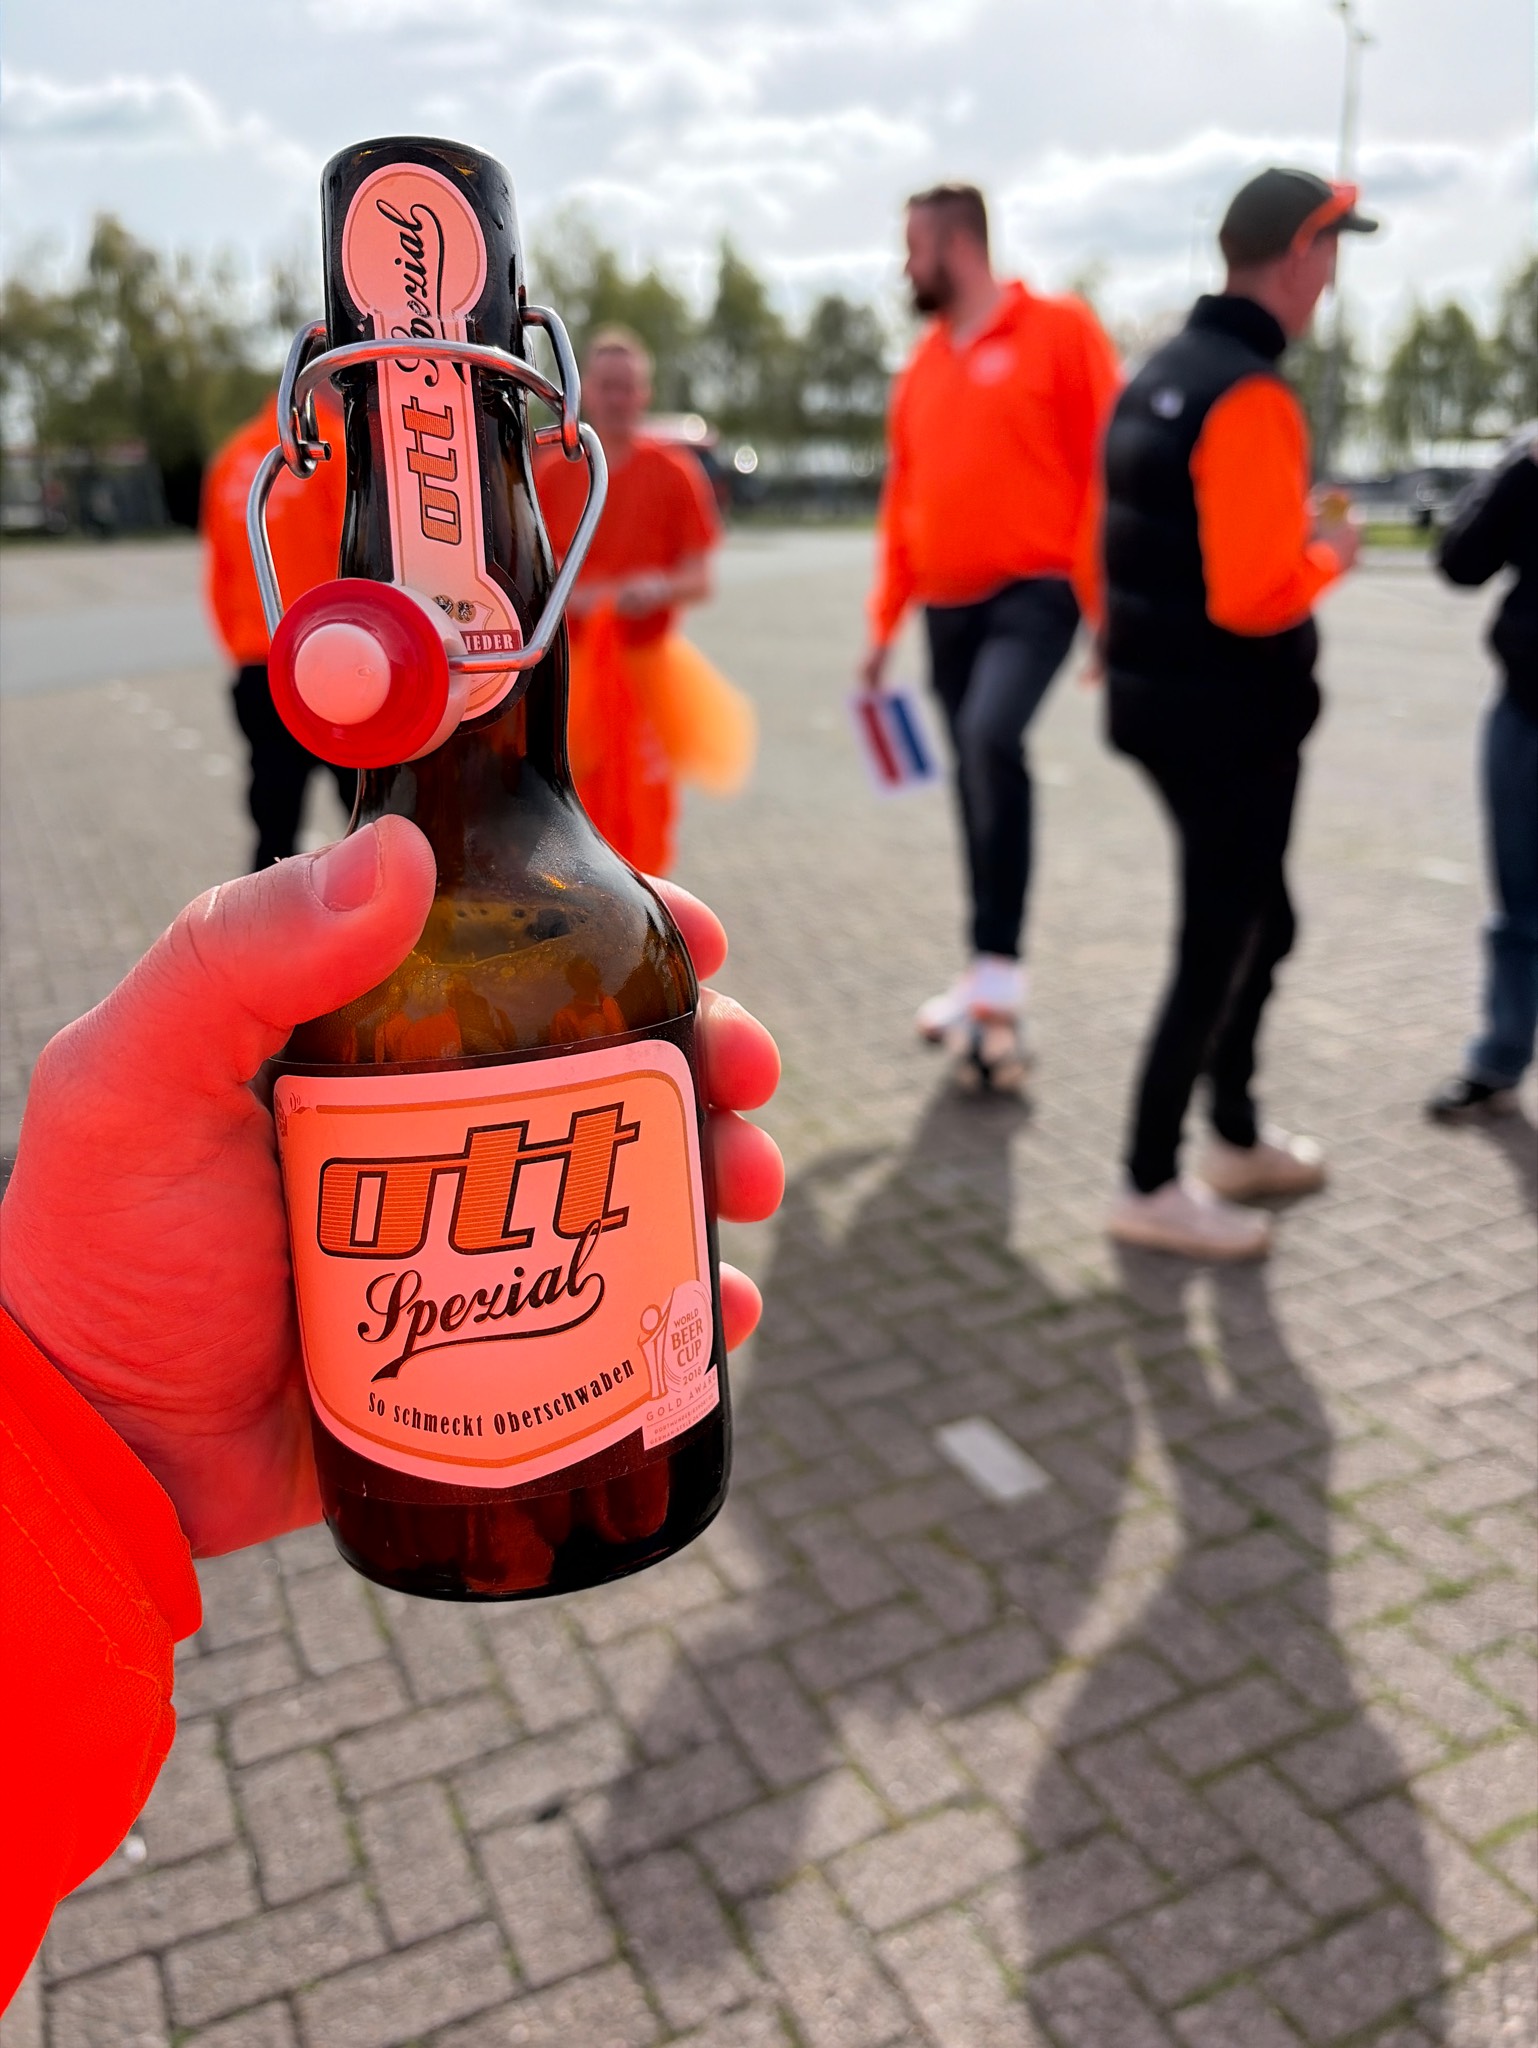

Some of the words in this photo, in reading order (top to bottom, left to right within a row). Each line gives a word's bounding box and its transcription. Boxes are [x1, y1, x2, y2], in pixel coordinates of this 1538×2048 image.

[401, 396, 462, 546] ott
[464, 633, 514, 652] IEDER
[316, 1101, 641, 1259] ott
[357, 1219, 605, 1382] Spezial
[671, 1318, 703, 1351] BEER
[673, 1308, 699, 1328] WORLD
[677, 1339, 702, 1368] CUP
[368, 1392, 386, 1416] So
[393, 1405, 483, 1436] schmeckt
[493, 1359, 635, 1435] Oberschwaben
[646, 1397, 682, 1422] GOLD
